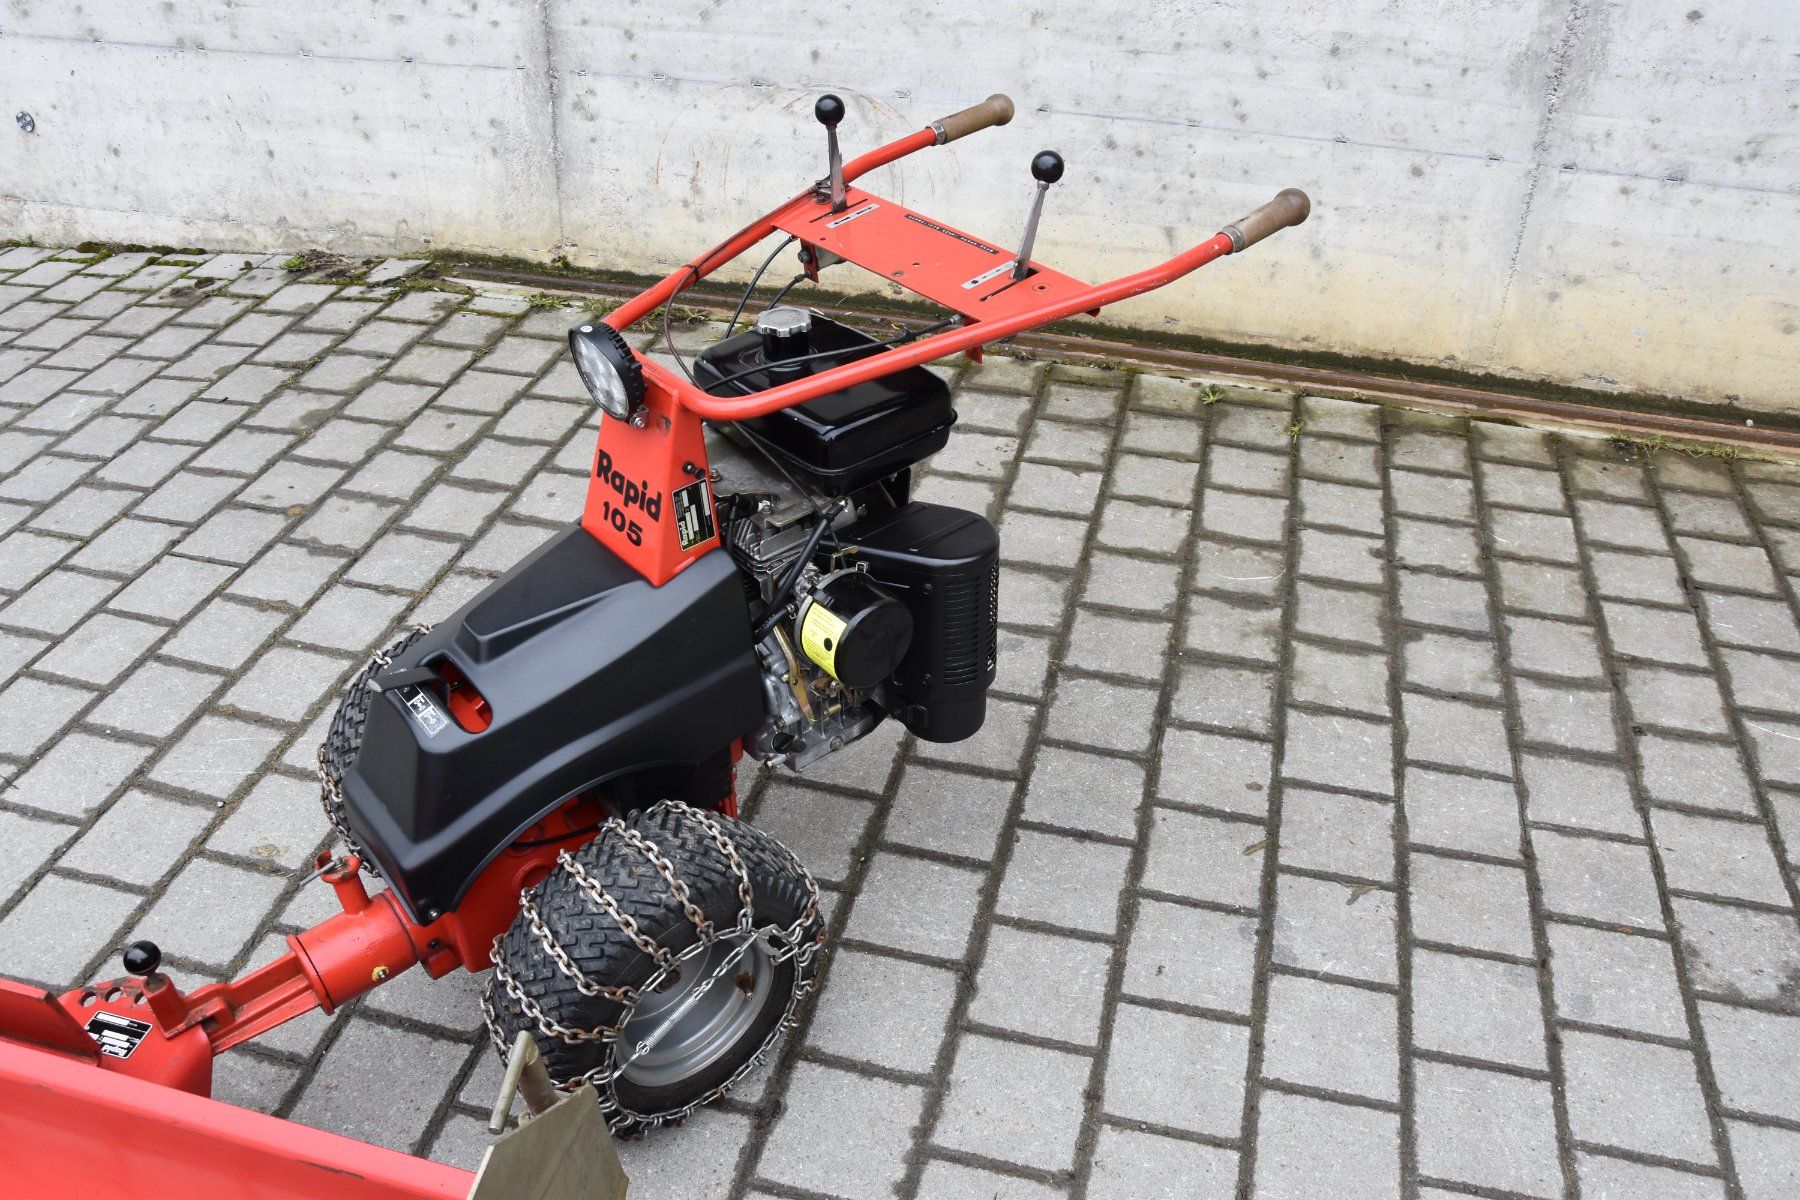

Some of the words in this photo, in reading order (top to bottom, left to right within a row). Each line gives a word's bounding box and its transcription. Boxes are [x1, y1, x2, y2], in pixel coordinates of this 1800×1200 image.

[597, 449, 661, 523] Rapid
[603, 502, 643, 546] 105
[678, 522, 688, 546] Rapid
